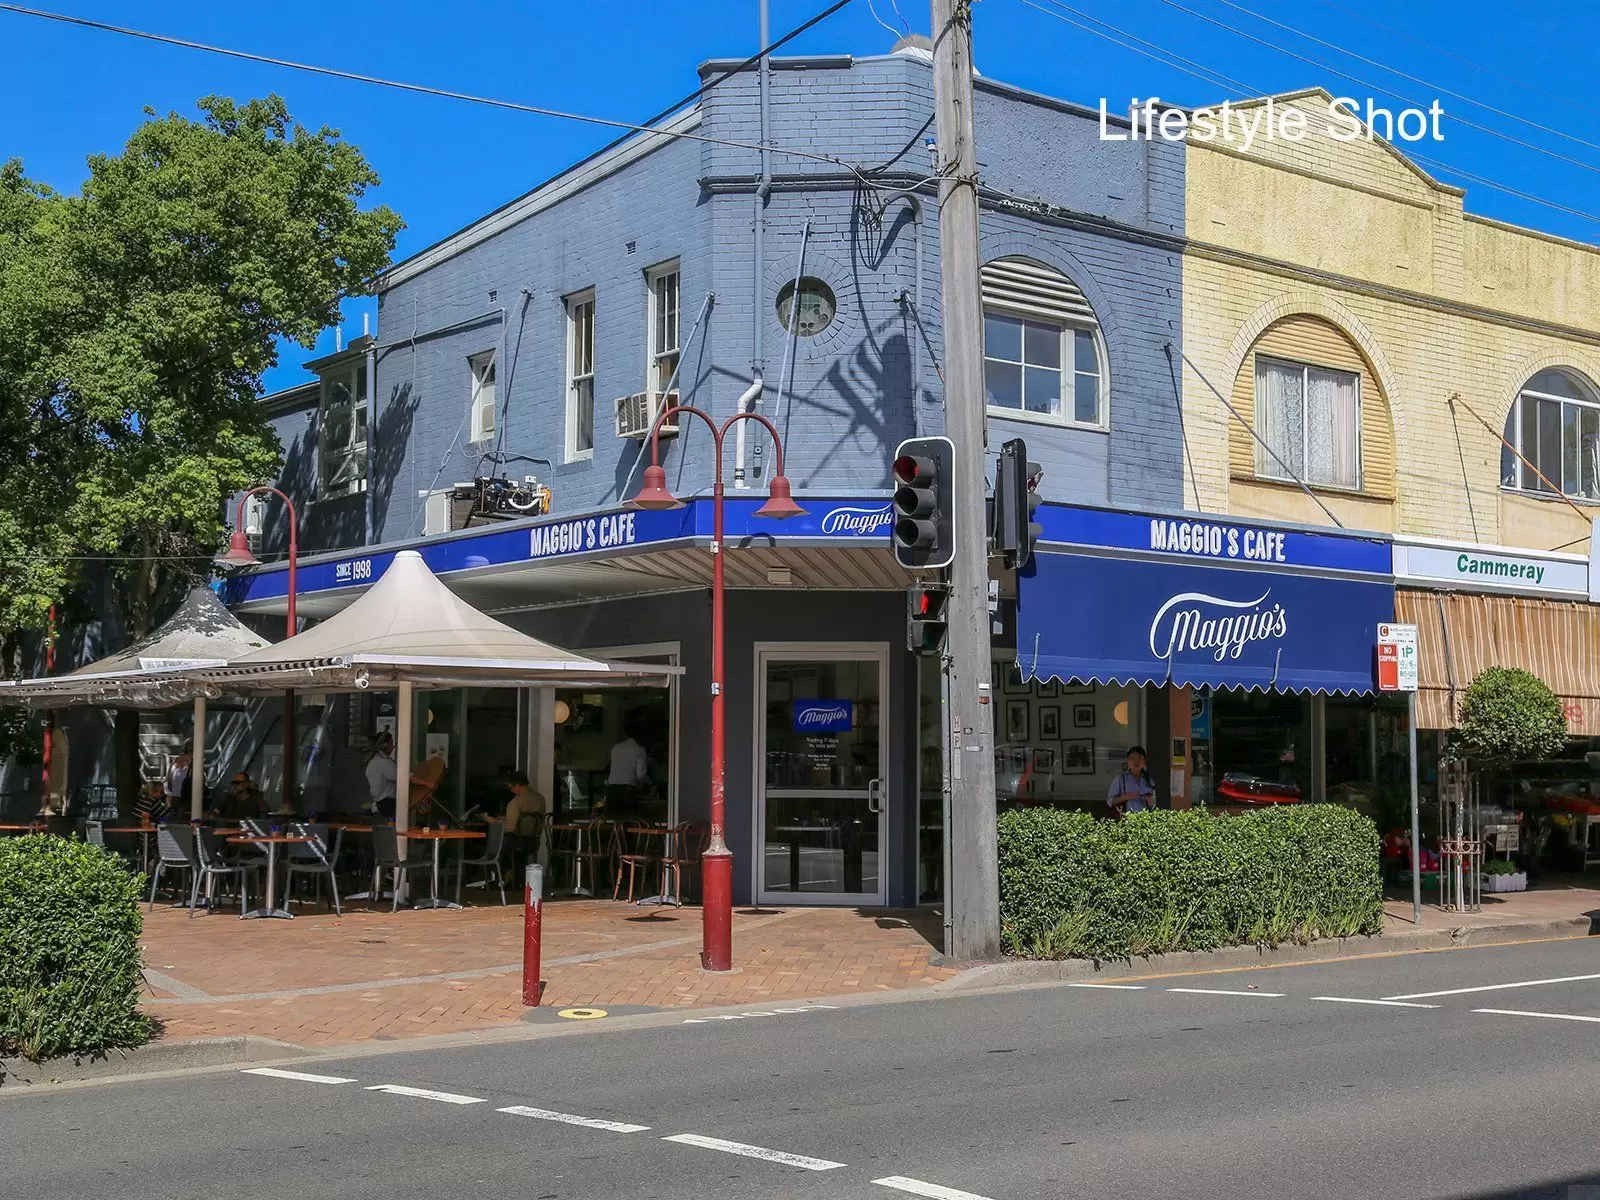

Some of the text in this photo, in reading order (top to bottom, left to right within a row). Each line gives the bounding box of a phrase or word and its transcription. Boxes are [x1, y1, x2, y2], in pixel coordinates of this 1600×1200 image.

[822, 502, 894, 534] Maggio
[530, 512, 635, 556] MAGGIO'S CAFE
[1151, 519, 1286, 561] MAGGIO'S CAFE
[336, 559, 371, 580] SINCE 1998
[1457, 553, 1545, 584] Cammeray
[1150, 587, 1287, 662] Maggio's
[1383, 646, 1393, 655] NO
[1401, 646, 1414, 658] 1P
[798, 706, 848, 725] Maggio's
